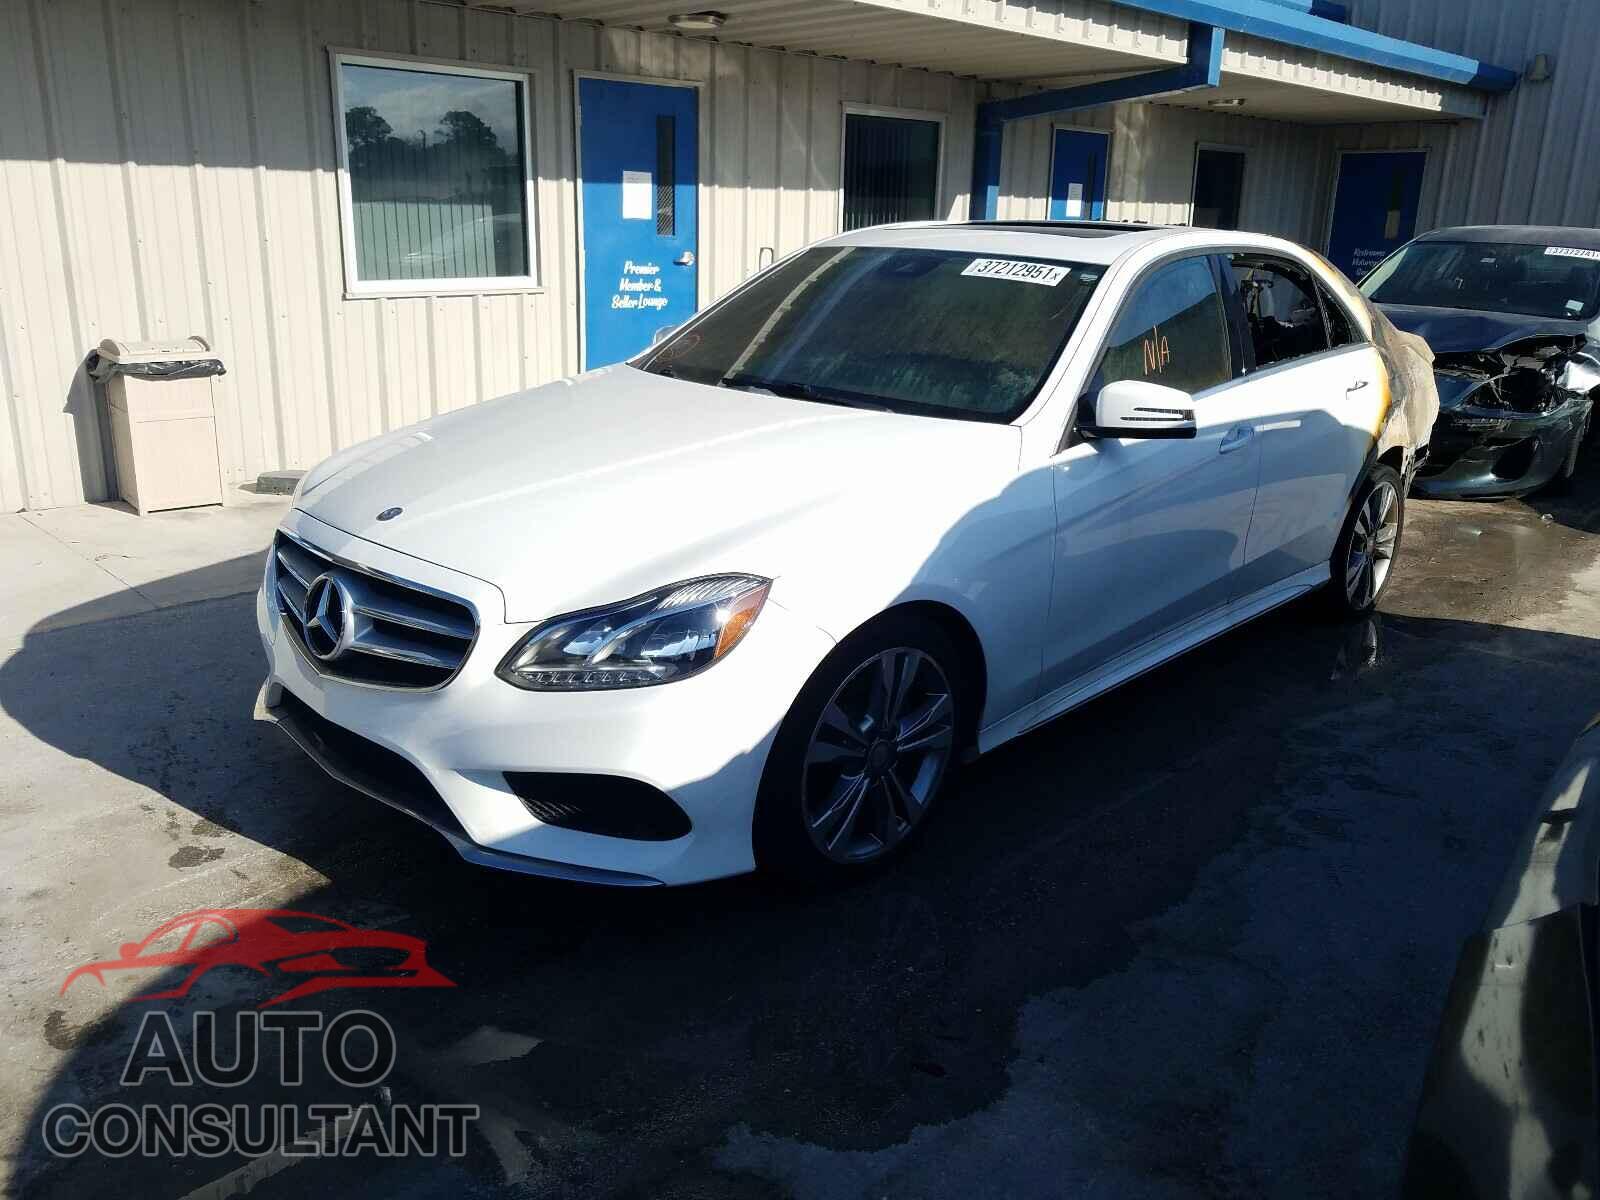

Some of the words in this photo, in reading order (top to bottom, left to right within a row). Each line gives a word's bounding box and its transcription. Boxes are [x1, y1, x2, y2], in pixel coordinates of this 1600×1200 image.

[623, 260, 661, 275] Premier
[619, 278, 654, 292] Member
[654, 278, 662, 292] &
[611, 294, 638, 309] Seller
[638, 293, 669, 311] Lounge
